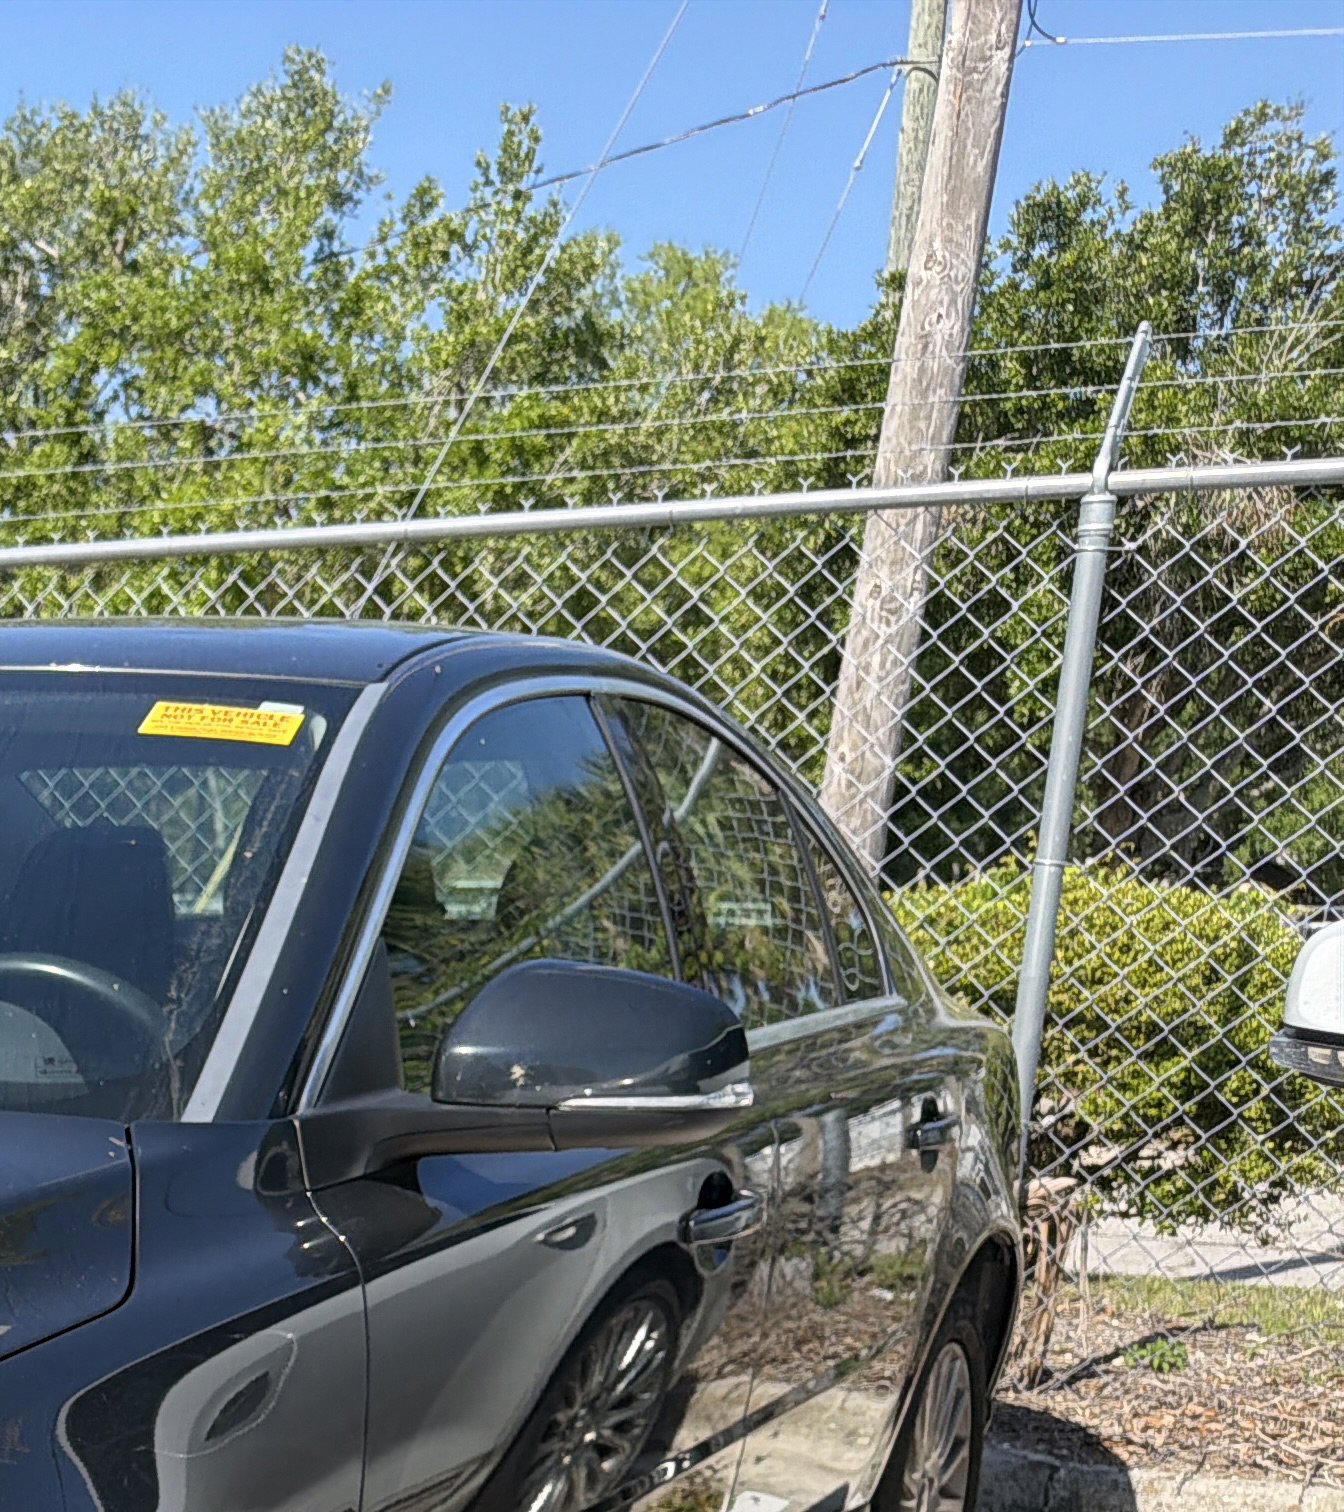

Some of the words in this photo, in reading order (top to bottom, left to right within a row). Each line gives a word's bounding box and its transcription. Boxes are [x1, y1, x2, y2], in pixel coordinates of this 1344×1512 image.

[160, 714, 195, 722] NOT
[200, 716, 234, 724] FOR
[241, 719, 281, 729] SALE
[164, 706, 204, 715] THIS
[211, 709, 291, 722] VEHICLE
